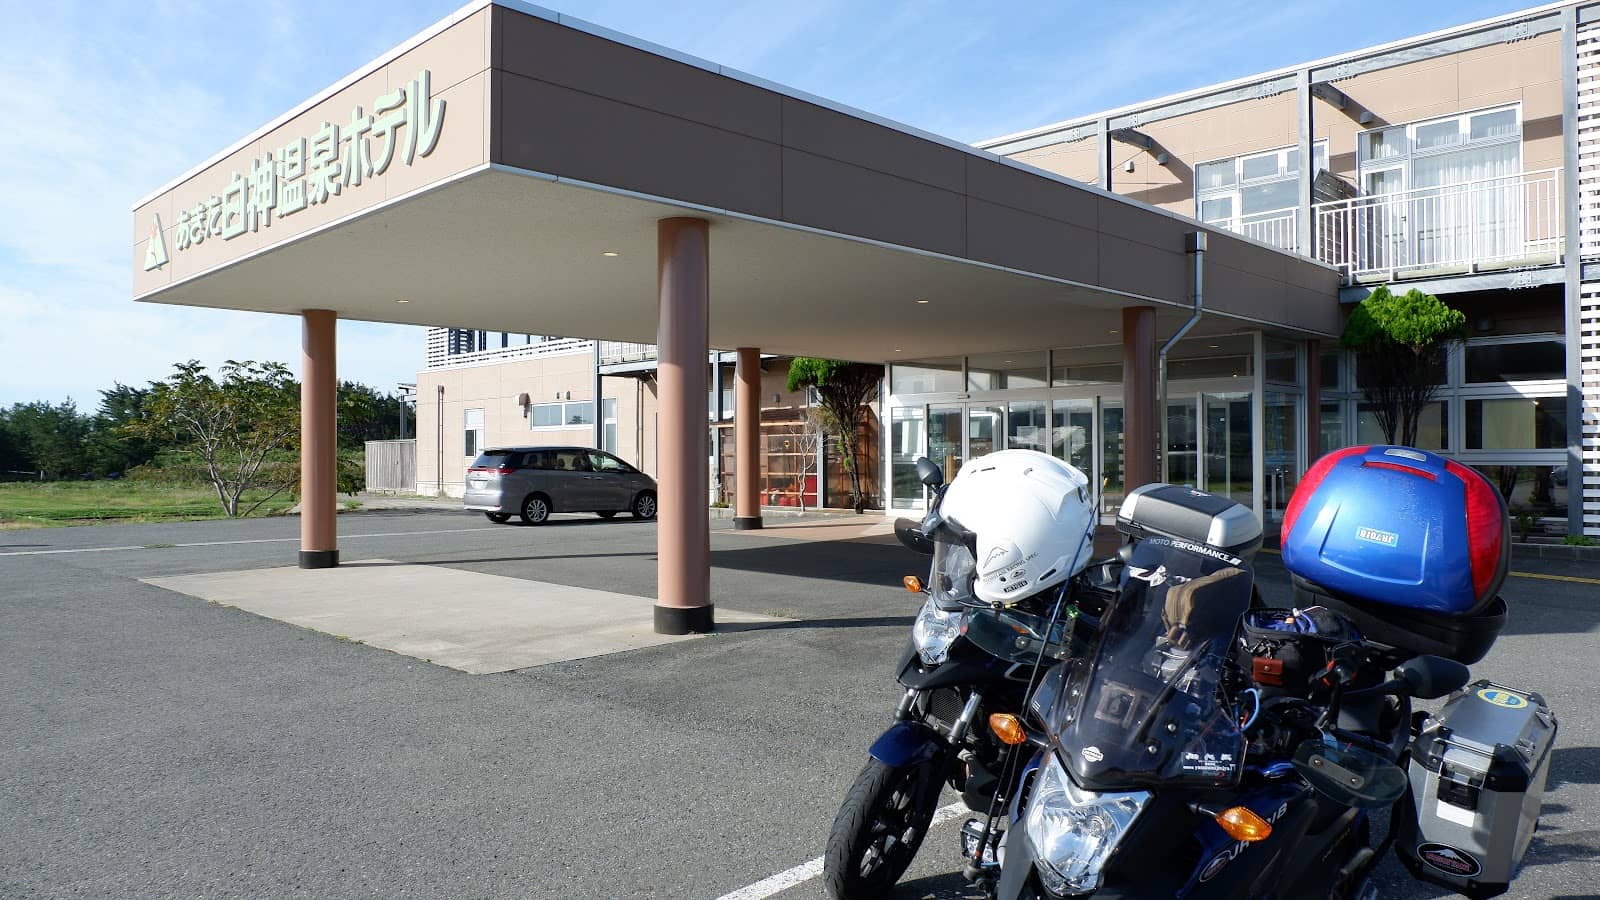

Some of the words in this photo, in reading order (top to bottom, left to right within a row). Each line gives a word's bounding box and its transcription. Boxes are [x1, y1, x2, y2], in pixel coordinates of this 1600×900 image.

[175, 68, 447, 251] あきた白神温泉ホテル
[1148, 537, 1170, 546] MOTO
[1170, 540, 1231, 562] PERFORMANCE
